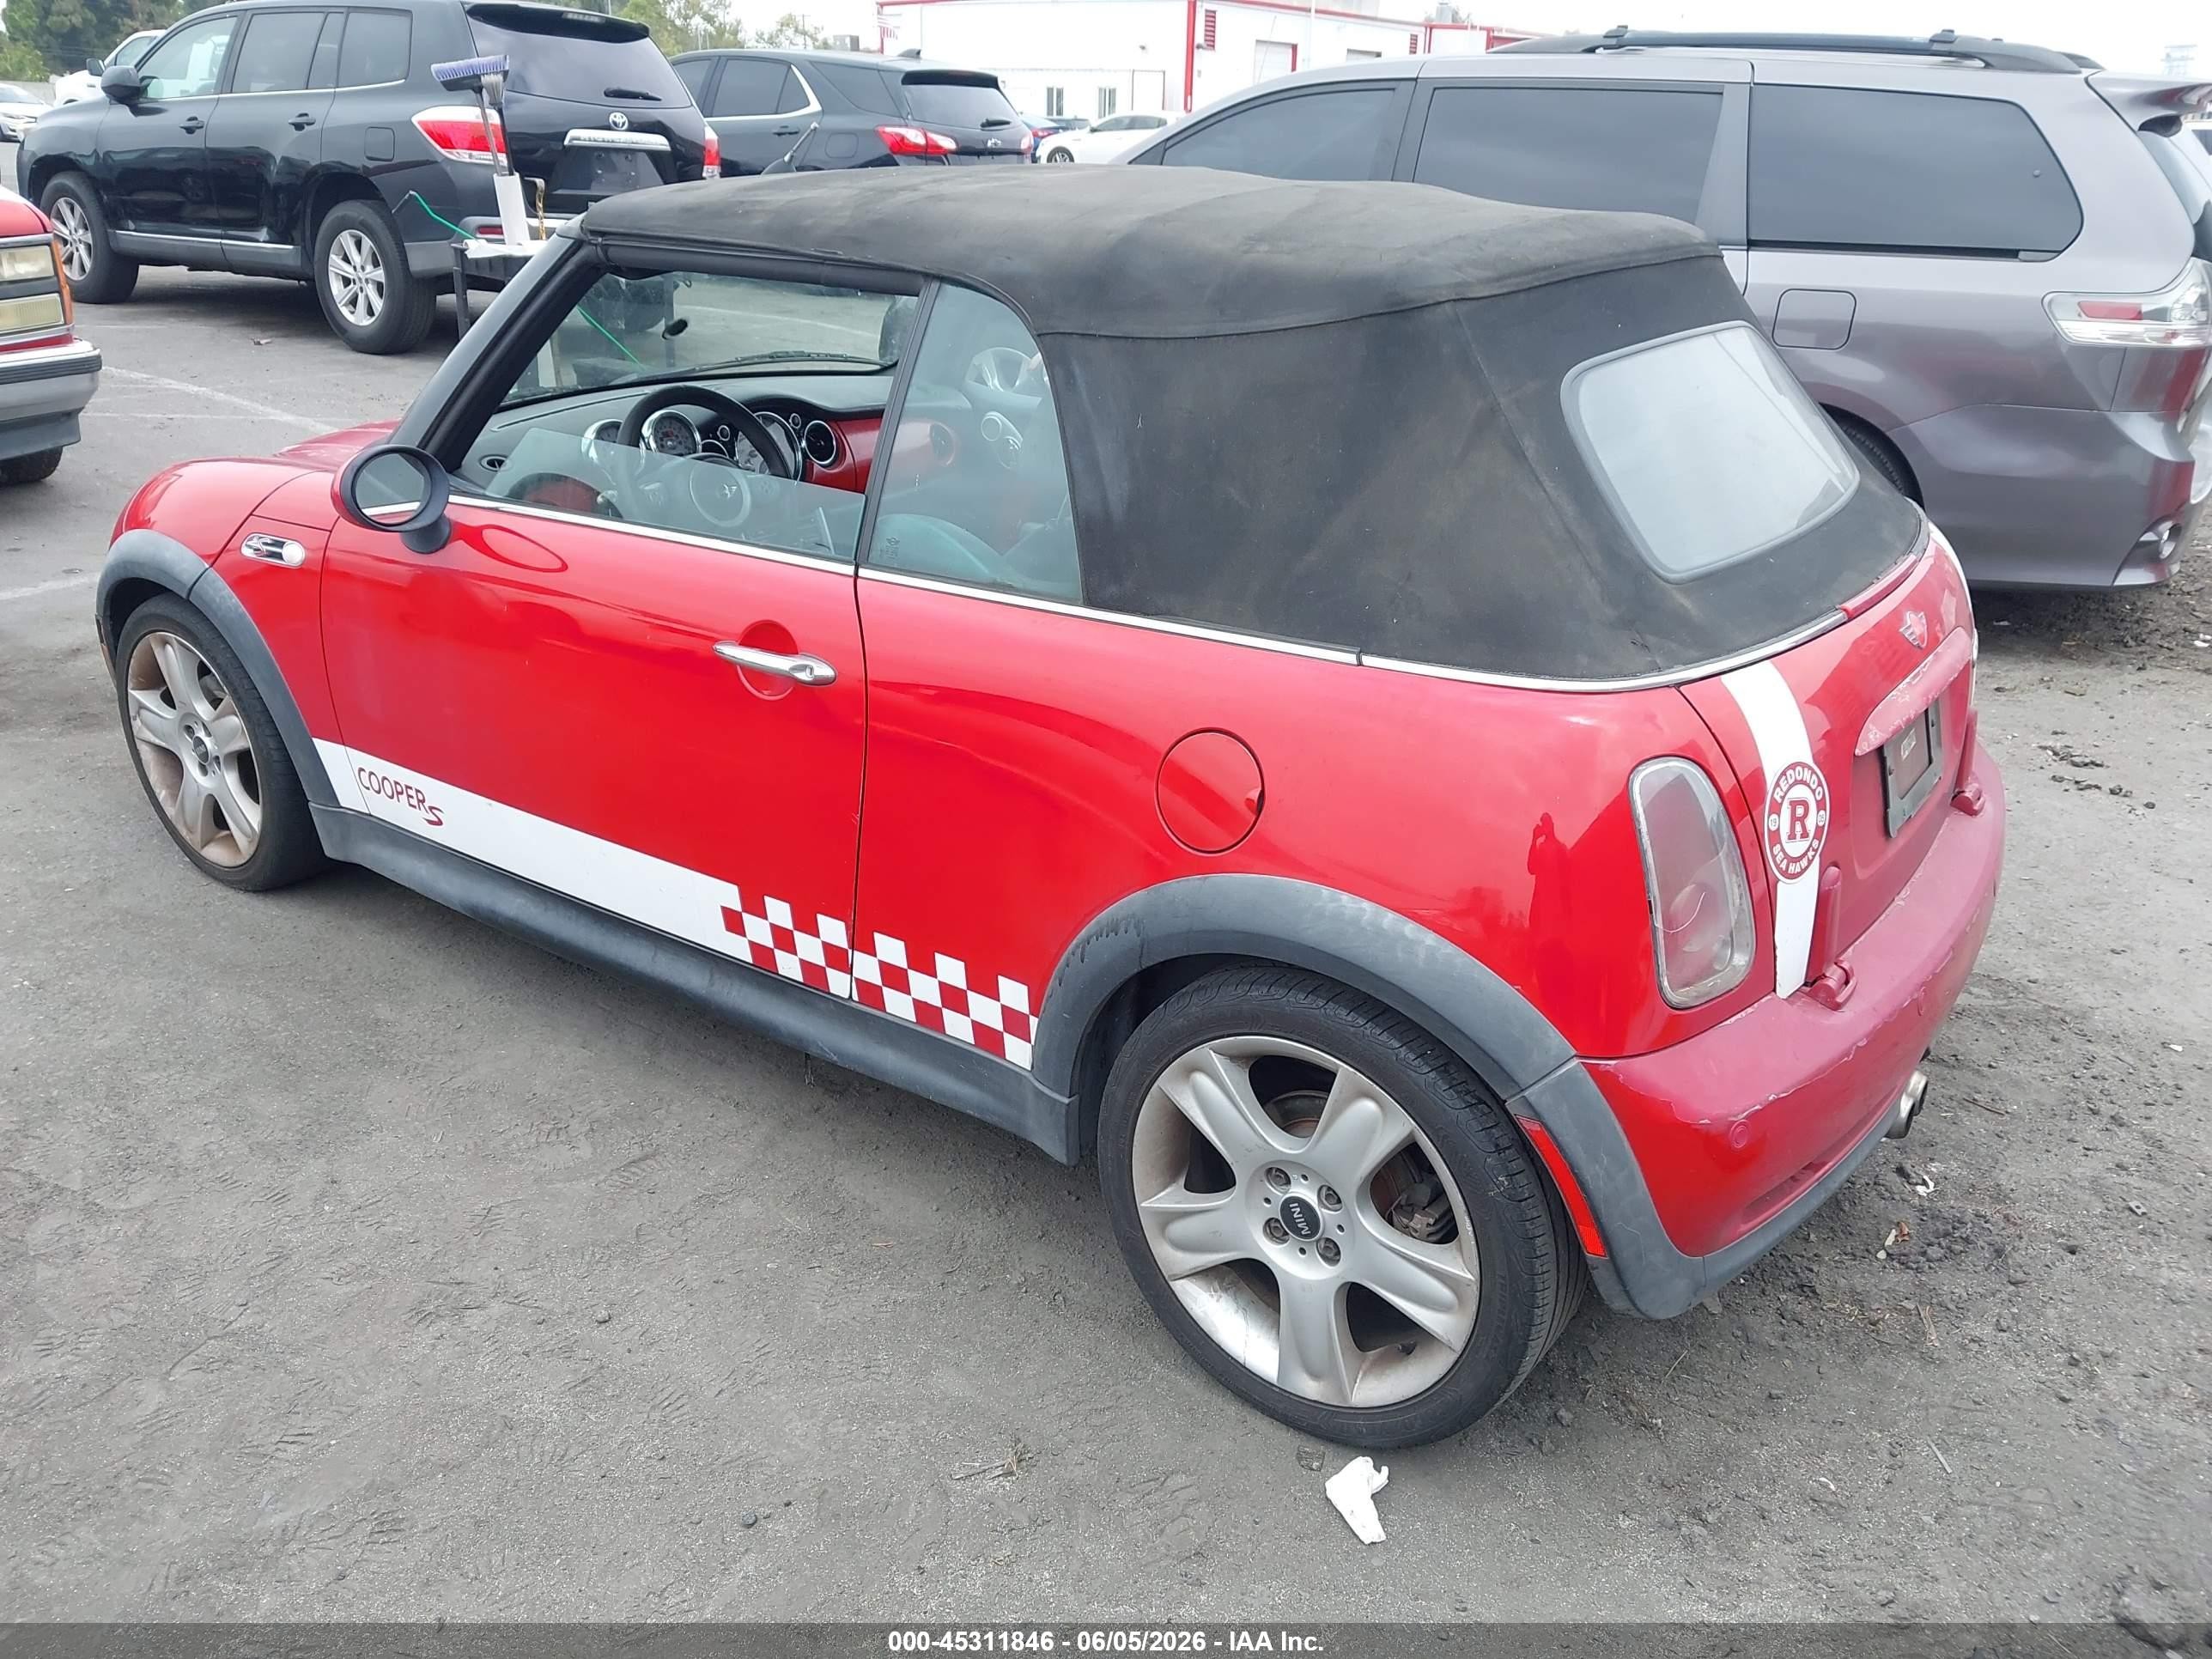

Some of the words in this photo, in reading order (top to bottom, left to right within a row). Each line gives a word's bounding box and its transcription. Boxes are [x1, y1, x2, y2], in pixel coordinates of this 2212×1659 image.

[1773, 766, 1823, 803] REDONDO
[1786, 799, 1810, 842] R
[1289, 1202, 1311, 1235] MINI
